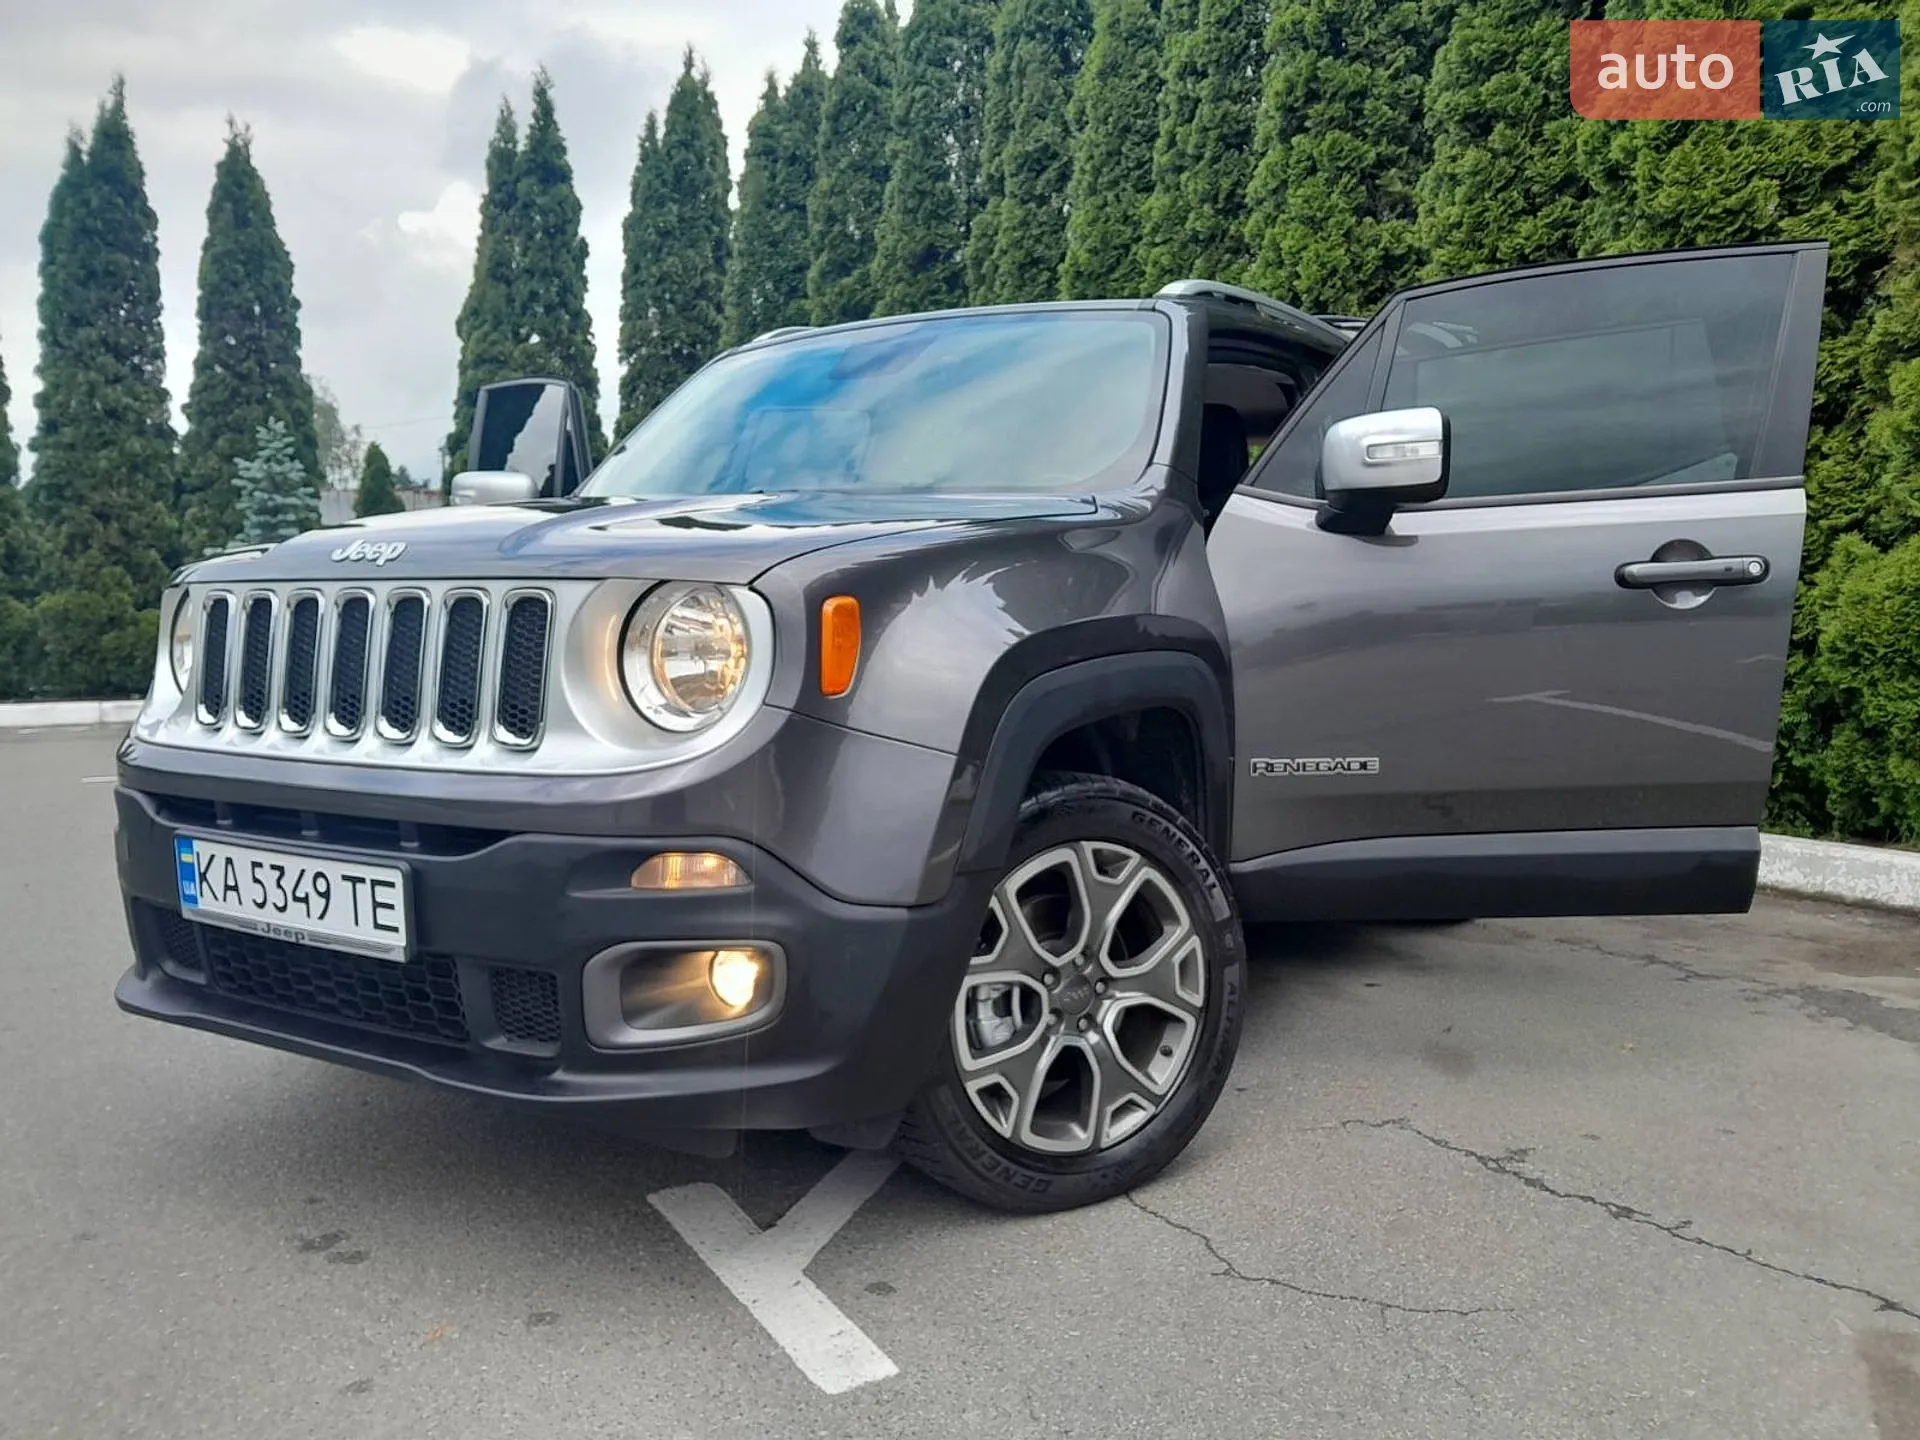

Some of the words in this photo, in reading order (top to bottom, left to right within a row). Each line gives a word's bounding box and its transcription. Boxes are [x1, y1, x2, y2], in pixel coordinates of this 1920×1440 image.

[331, 539, 407, 567] Jeep
[1250, 757, 1380, 777] RENEGADE
[1131, 810, 1218, 901] GENERAL
[196, 851, 242, 906] KA
[250, 860, 331, 921] 5349
[341, 874, 400, 934] TE
[260, 922, 306, 943] Jeep
